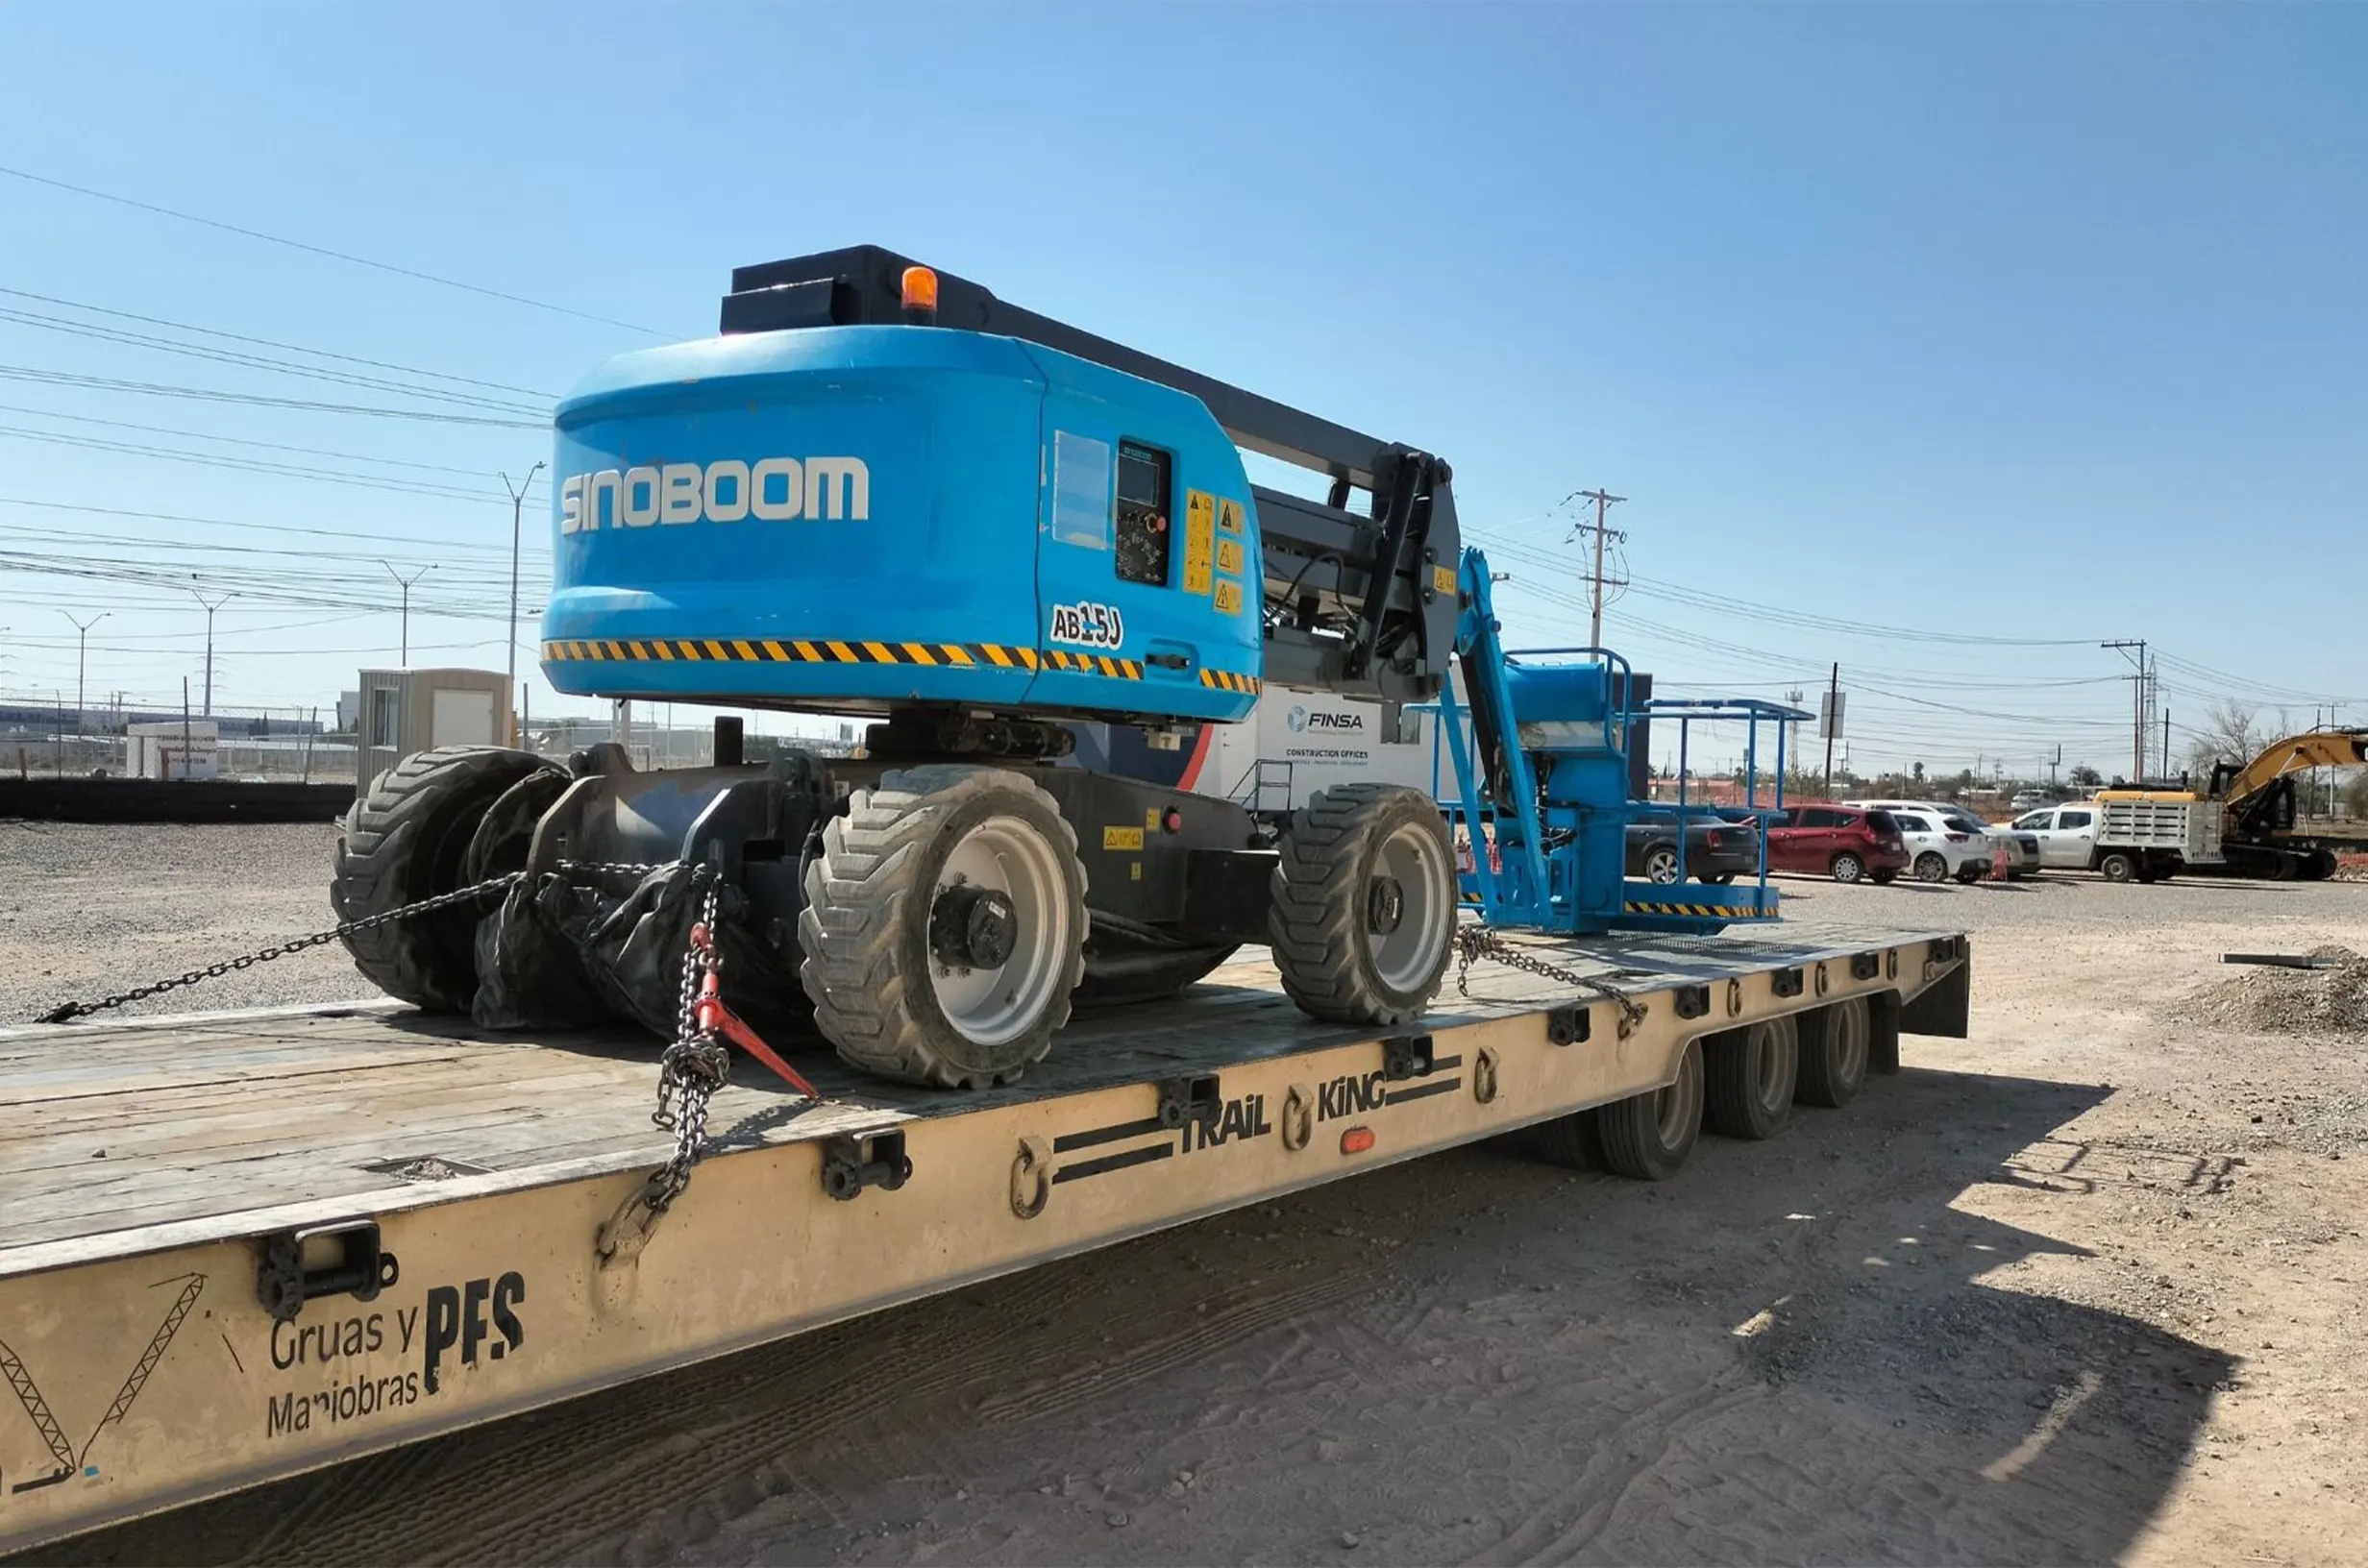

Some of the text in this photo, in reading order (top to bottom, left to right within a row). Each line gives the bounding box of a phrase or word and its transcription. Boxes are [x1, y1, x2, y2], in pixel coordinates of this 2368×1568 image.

[560, 456, 869, 535] SINOBOOM
[1052, 604, 1122, 647] AB15J
[1308, 713, 1363, 729] FINSA
[1286, 748, 1369, 759] CONSTRUCTION OFFICES
[270, 1312, 383, 1370] Gruas
[424, 1270, 525, 1395] PFS
